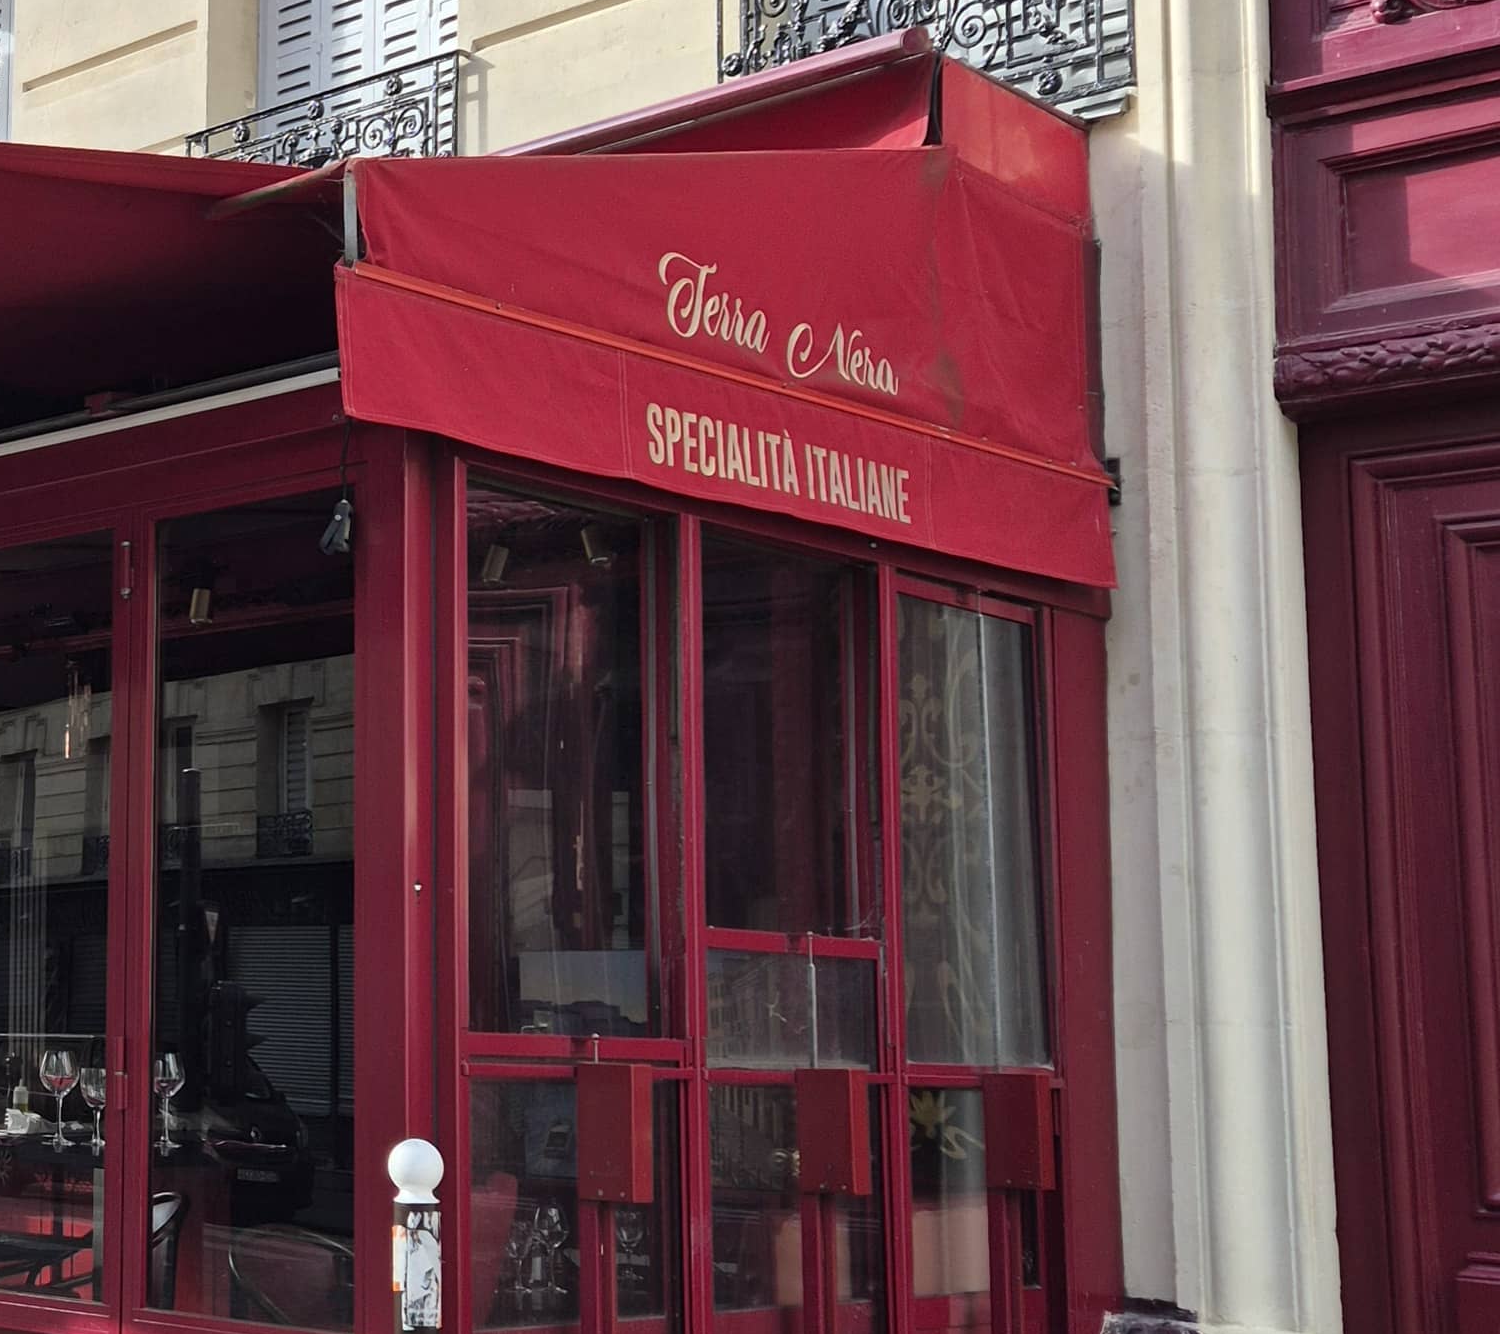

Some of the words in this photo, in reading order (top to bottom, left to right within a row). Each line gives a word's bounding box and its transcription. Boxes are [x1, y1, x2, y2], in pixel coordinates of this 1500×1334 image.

[658, 251, 771, 355] Terra
[786, 322, 900, 396] Nera
[646, 402, 800, 497] SPECIALITÀ
[804, 443, 912, 525] ITALIANE
